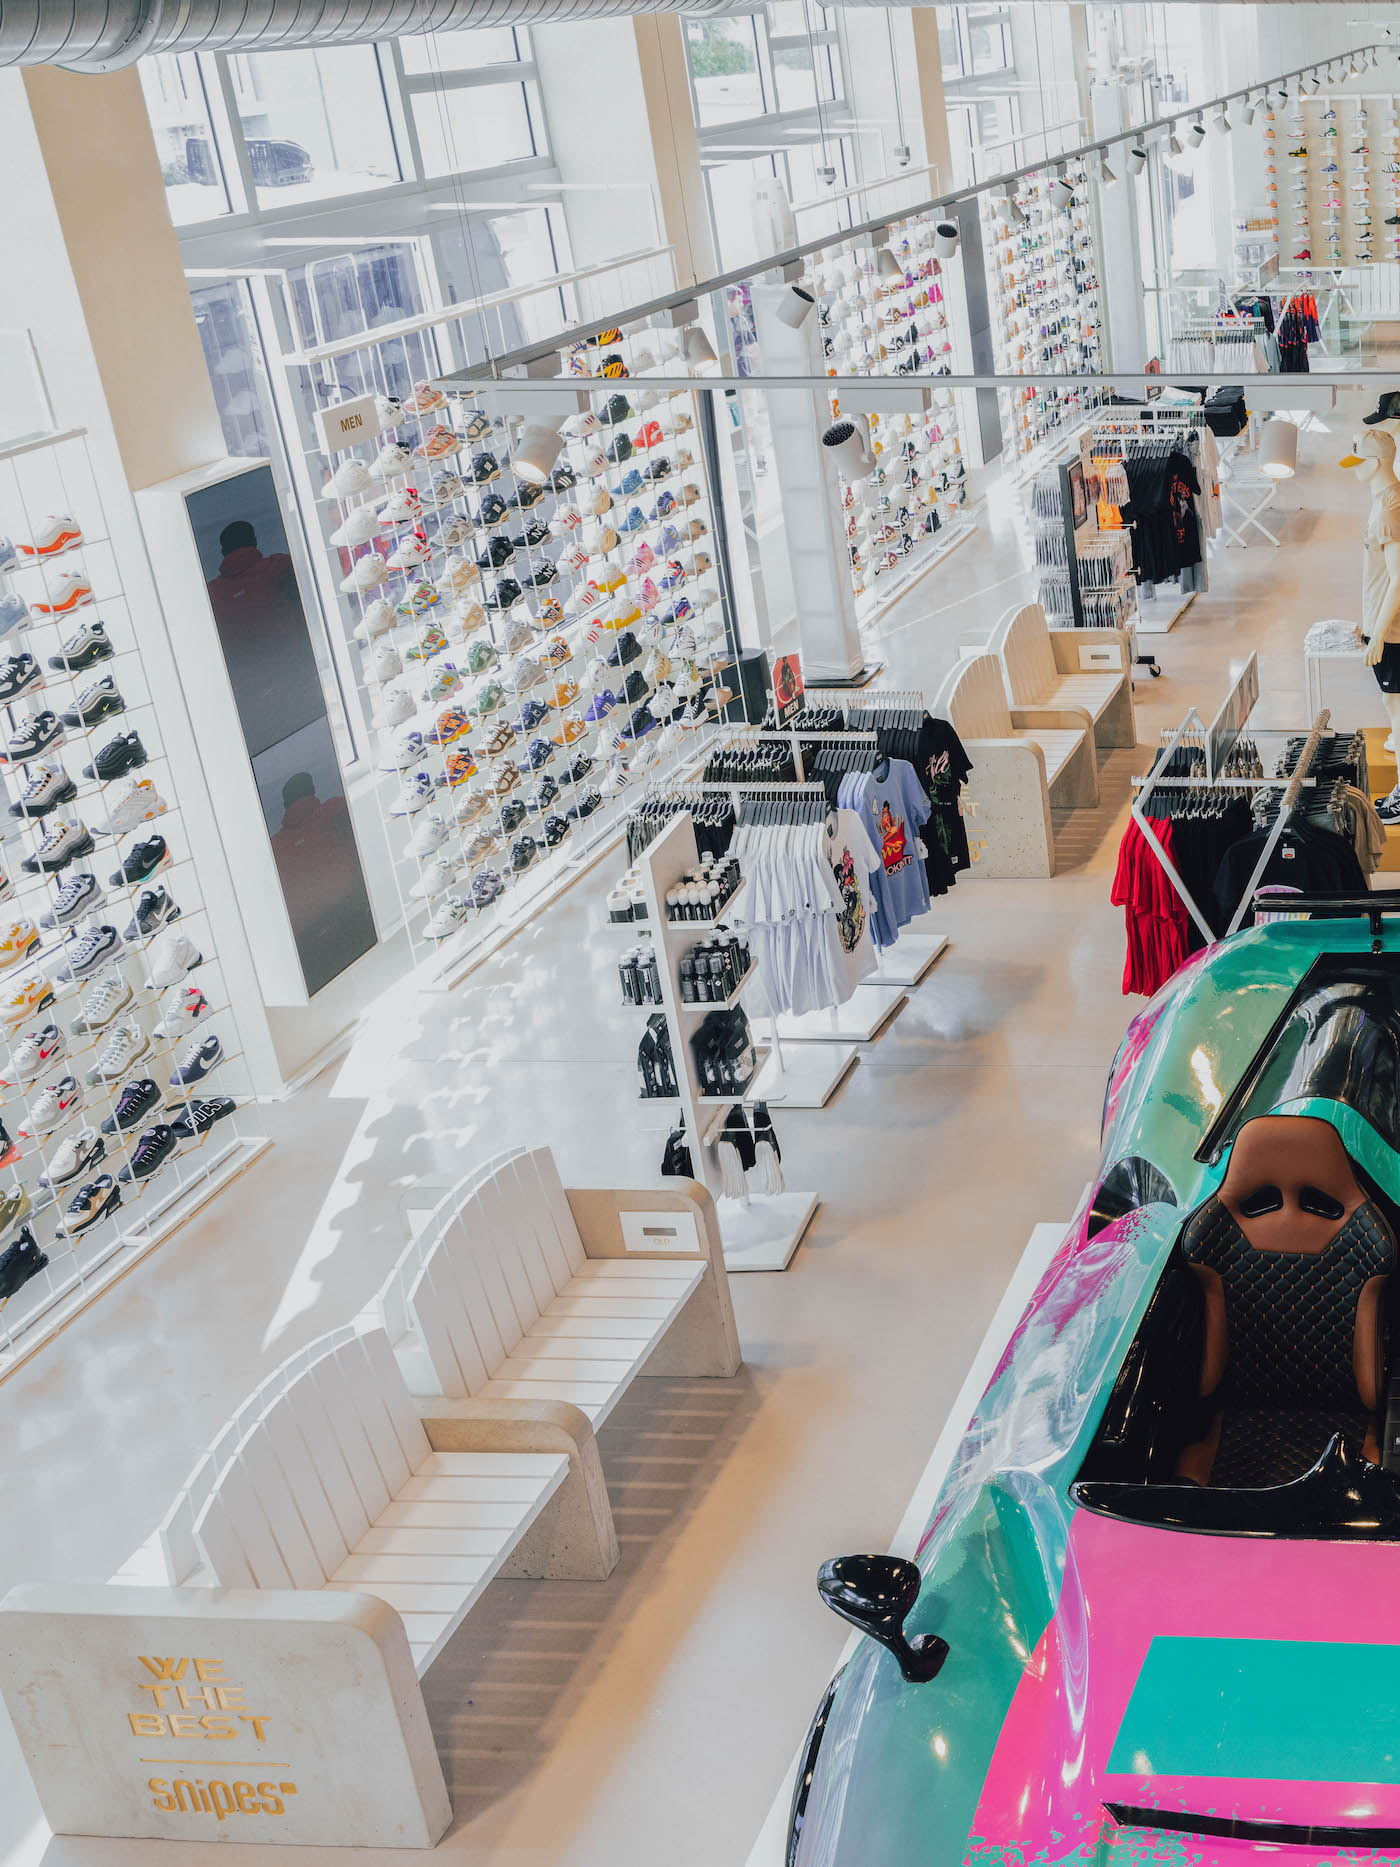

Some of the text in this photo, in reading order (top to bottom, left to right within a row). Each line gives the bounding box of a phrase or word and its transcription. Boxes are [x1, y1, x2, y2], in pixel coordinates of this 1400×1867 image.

[340, 413, 363, 432] MEN
[783, 701, 799, 719] MEN
[185, 1103, 222, 1129] AIR
[137, 1655, 230, 1682] WE
[137, 1684, 250, 1711] THE
[128, 1712, 273, 1744] BEST
[149, 1777, 286, 1822] snipes
